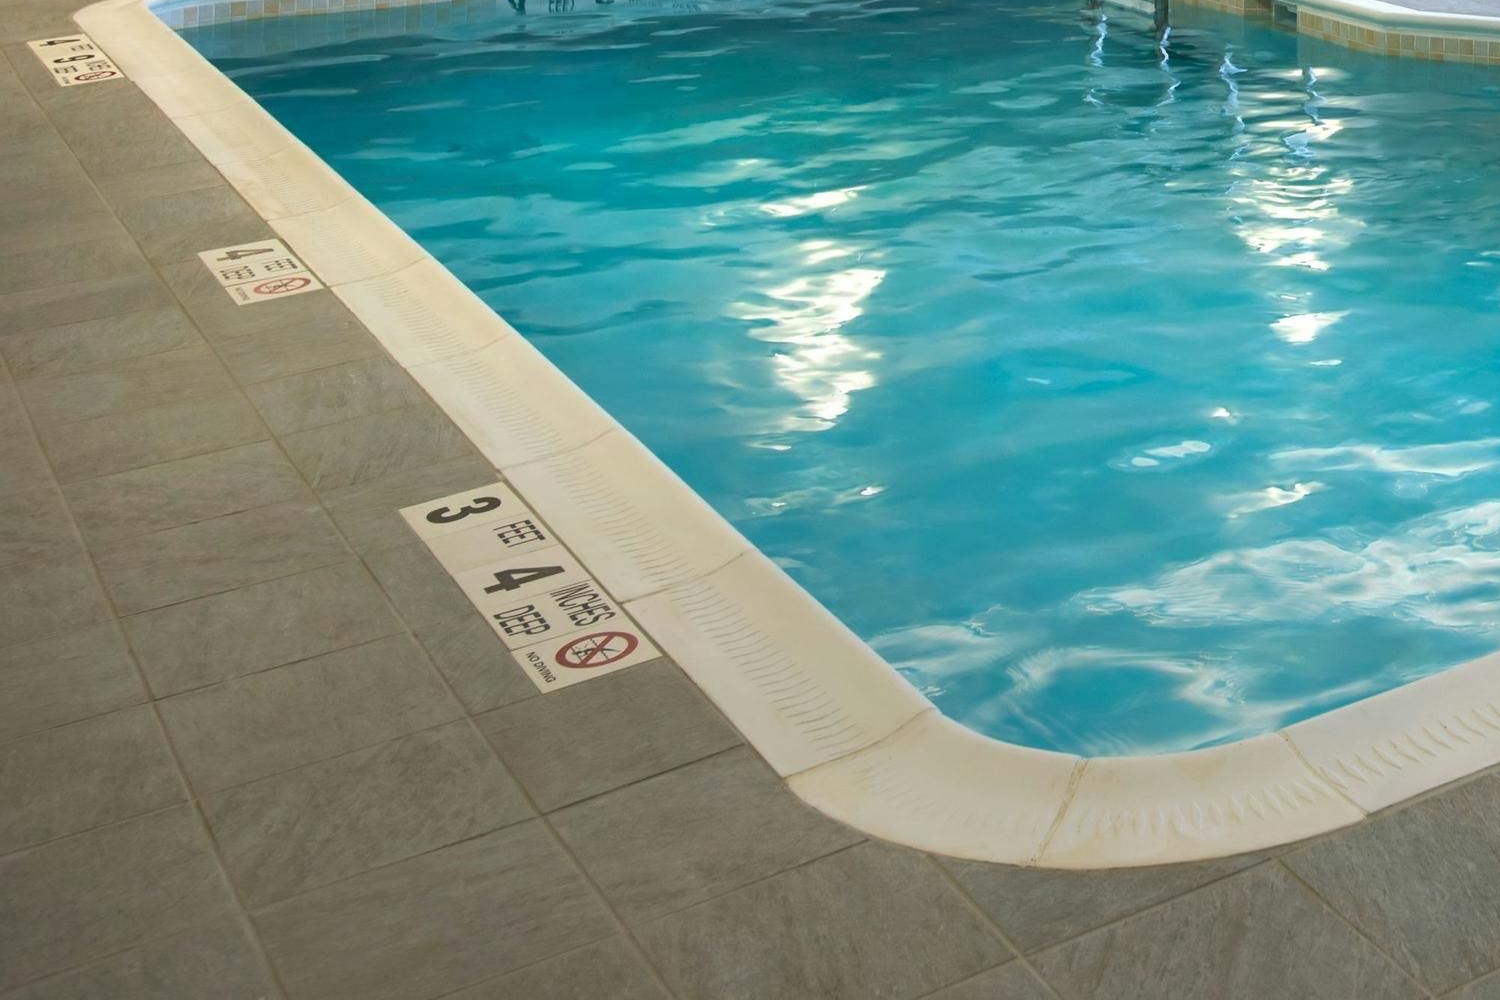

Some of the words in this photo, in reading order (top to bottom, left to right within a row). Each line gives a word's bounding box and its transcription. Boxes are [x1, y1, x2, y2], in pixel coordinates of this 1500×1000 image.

[217, 248, 274, 261] 4
[426, 496, 502, 524] 3
[493, 519, 546, 548] FEET
[484, 565, 566, 594] 4
[550, 582, 616, 627] INCHES
[493, 604, 551, 637] DEEP
[526, 651, 540, 663] NO
[533, 661, 557, 684] DIVING
